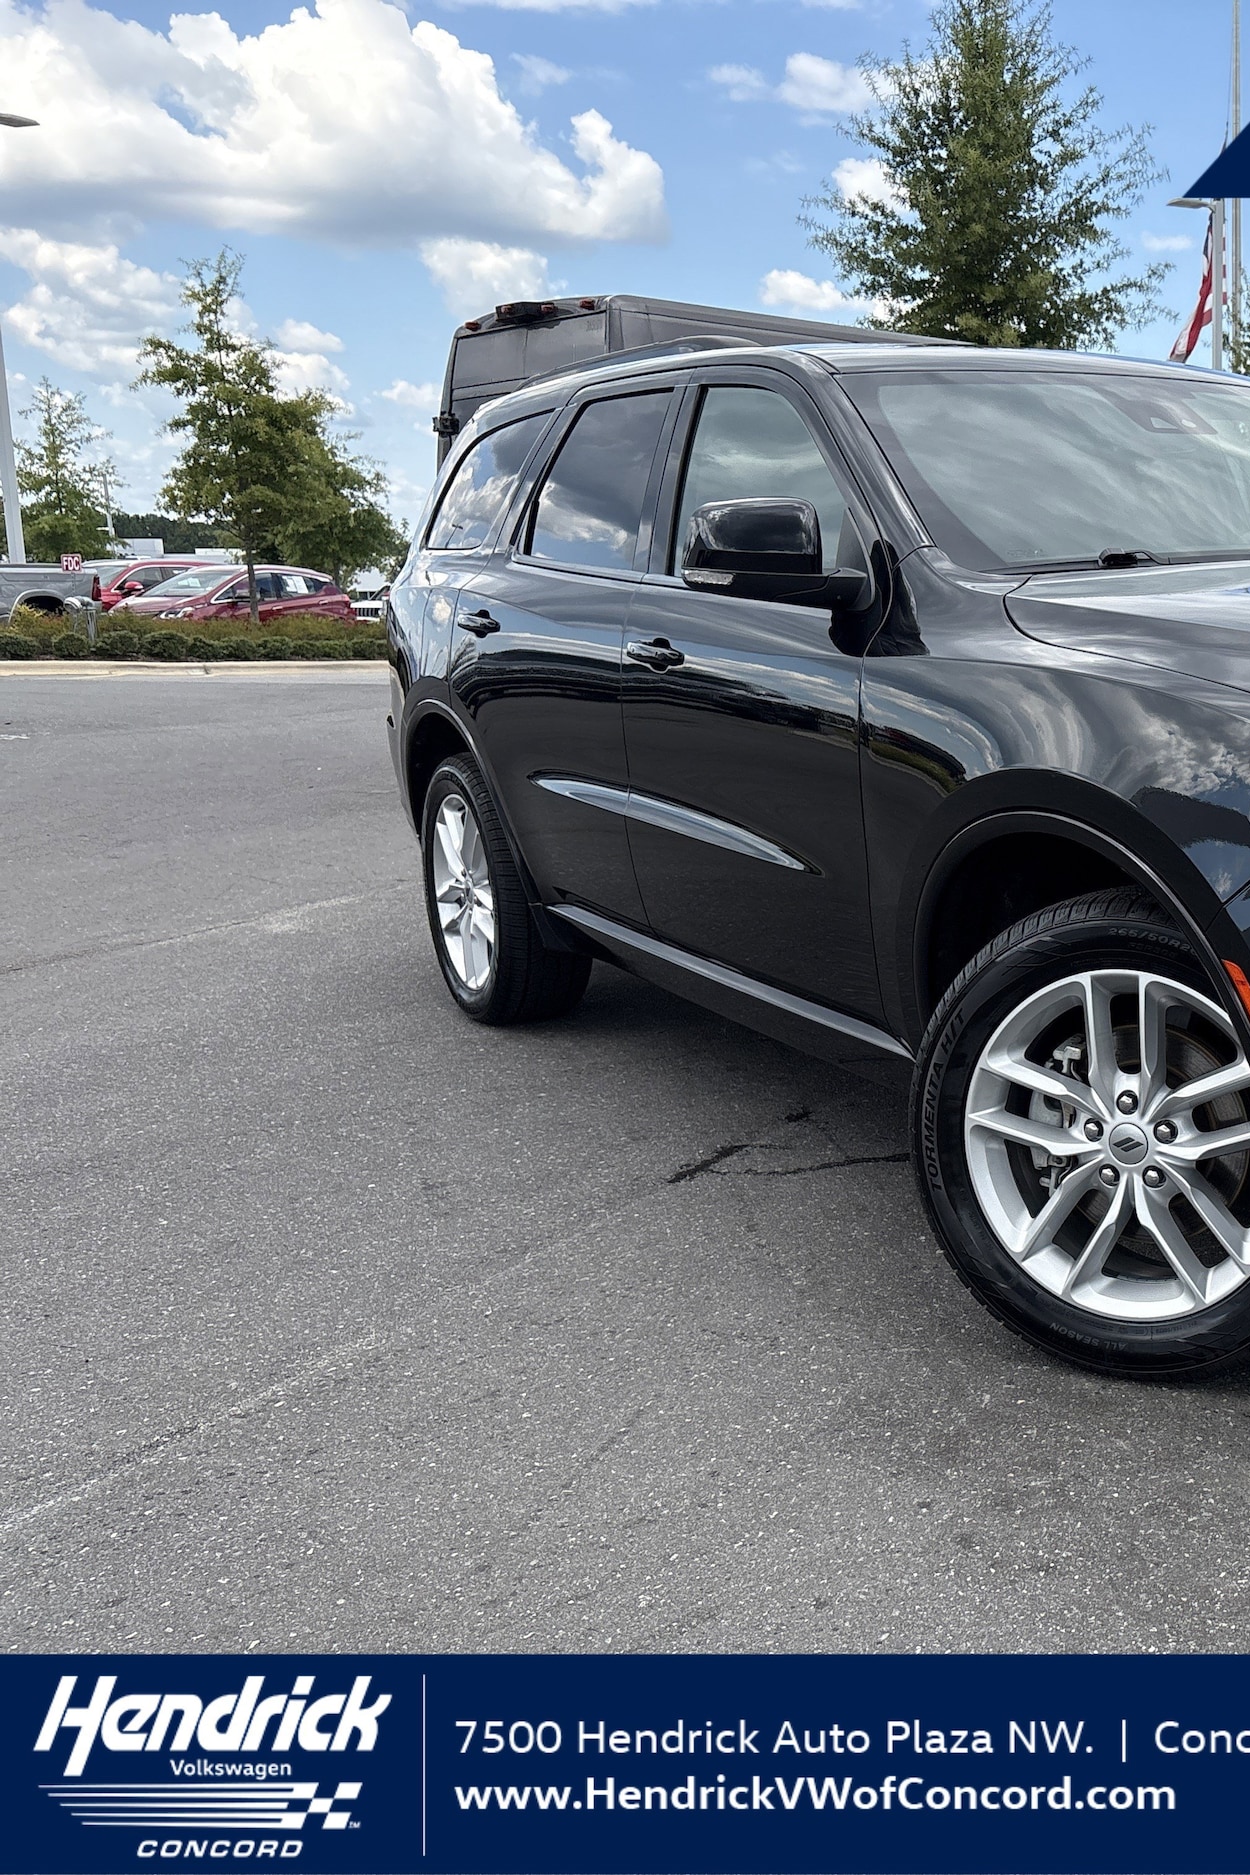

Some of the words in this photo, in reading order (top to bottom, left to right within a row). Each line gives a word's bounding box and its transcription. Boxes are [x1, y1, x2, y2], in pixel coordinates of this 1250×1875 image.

[62, 556, 80, 571] FDC
[923, 1061, 945, 1193] TORMENTA
[1049, 1321, 1100, 1346] SEASON
[1104, 1341, 1128, 1351] ALL
